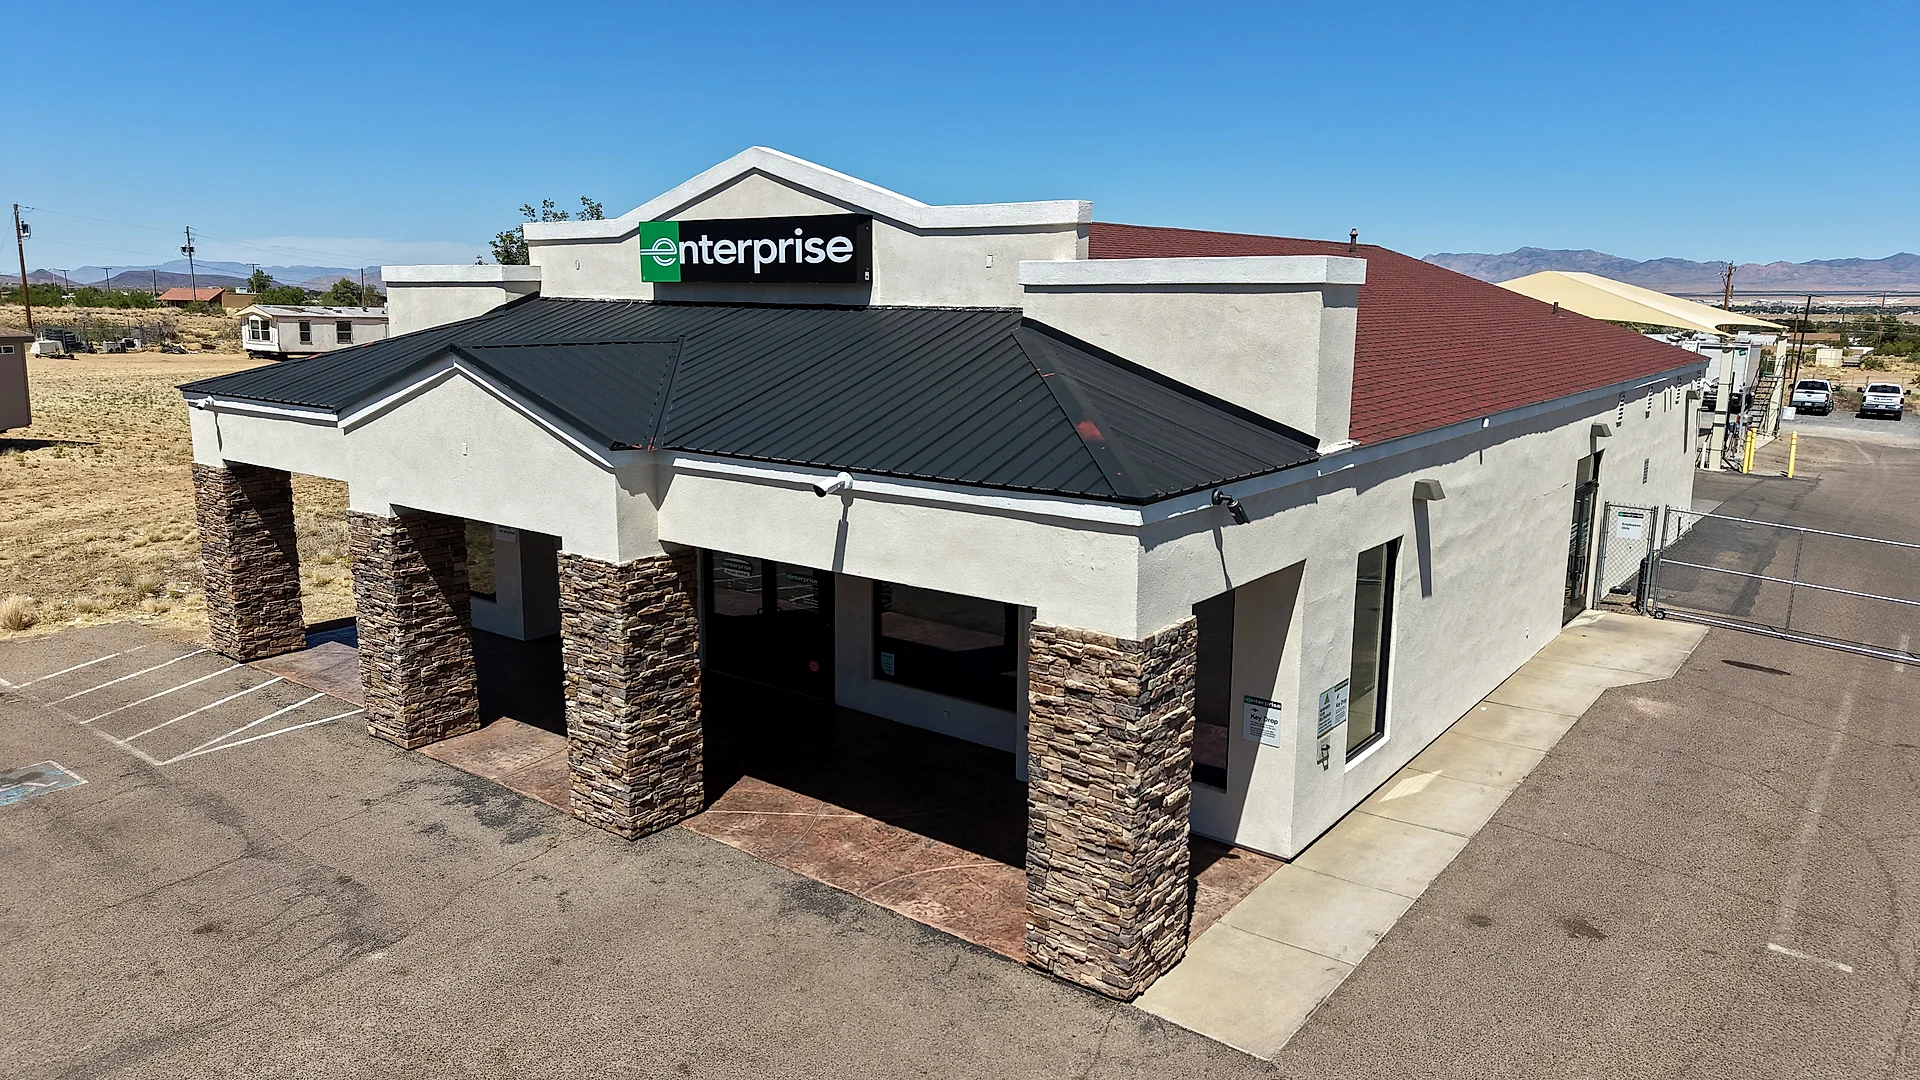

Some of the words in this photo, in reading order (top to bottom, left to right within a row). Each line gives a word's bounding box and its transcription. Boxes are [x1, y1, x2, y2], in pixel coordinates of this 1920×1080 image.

[640, 228, 853, 274] enterprise
[722, 561, 752, 572] enterprise
[786, 574, 818, 584] enterprise
[1245, 698, 1281, 709] enterprise
[1250, 713, 1262, 722] Key
[1263, 716, 1279, 725] Drop
